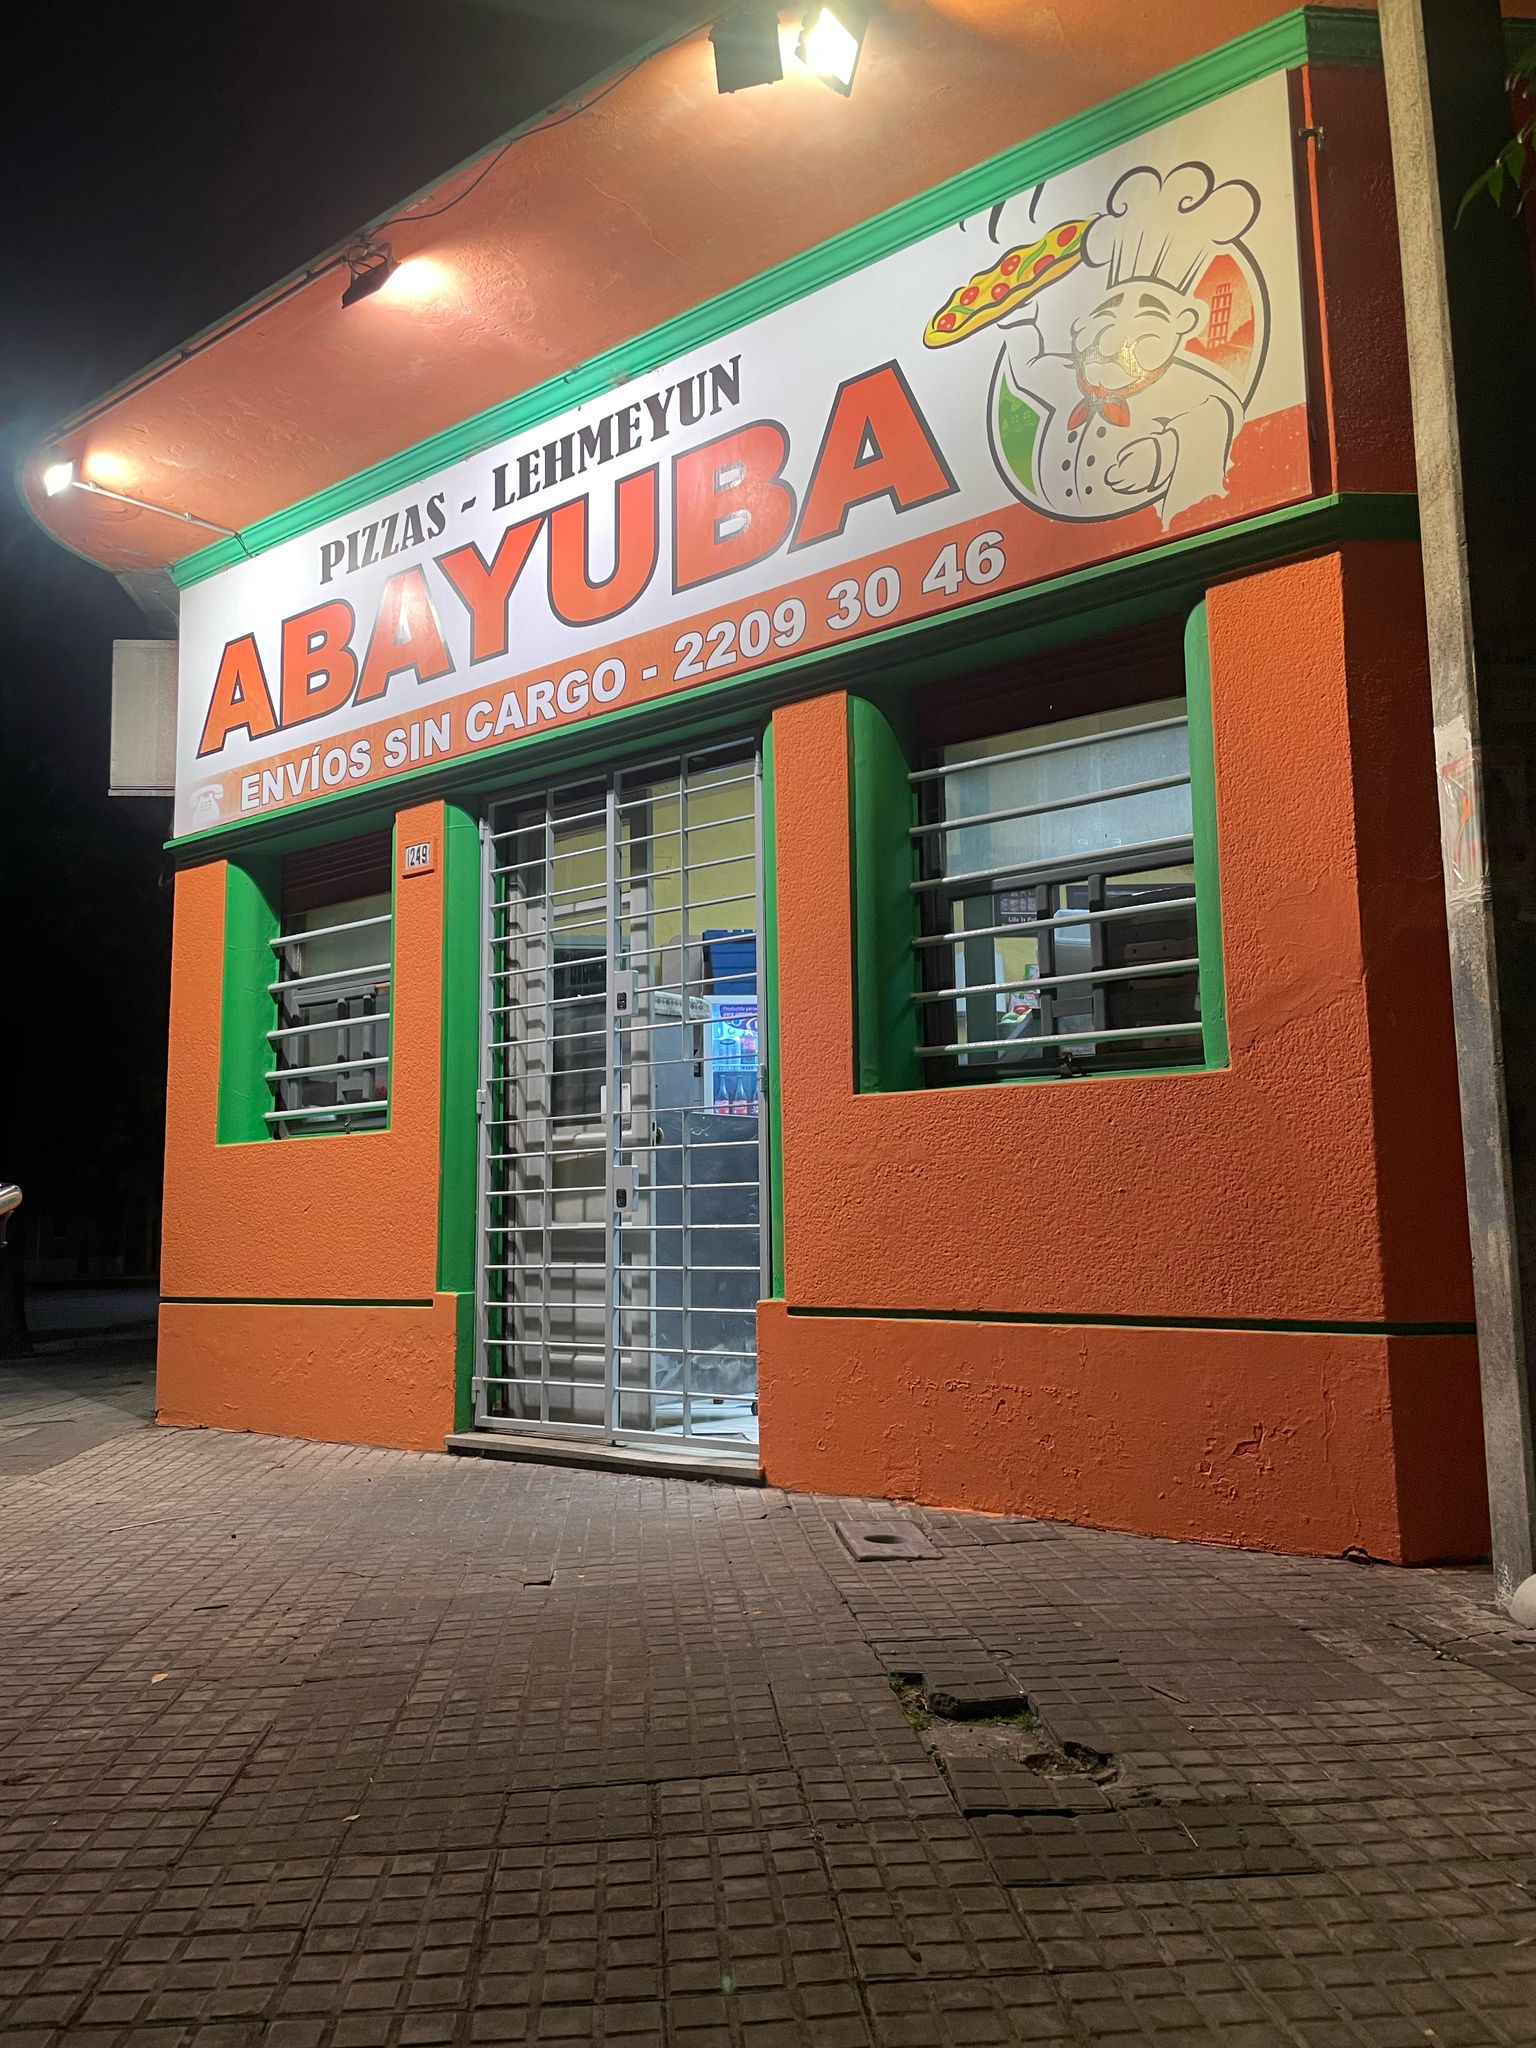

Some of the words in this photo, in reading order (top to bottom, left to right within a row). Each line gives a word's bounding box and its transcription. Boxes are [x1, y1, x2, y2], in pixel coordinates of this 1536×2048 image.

[196, 358, 961, 759] ABAYUBA
[320, 492, 446, 586] PIZZAS
[491, 354, 742, 512] LEHMEYUN
[240, 738, 372, 812] ENVÍOS
[384, 711, 452, 768] SIN
[465, 657, 627, 742] CARGO
[673, 598, 807, 682] 2209
[826, 565, 901, 631] 30
[921, 530, 1007, 596] 46
[406, 844, 428, 868] 1249
